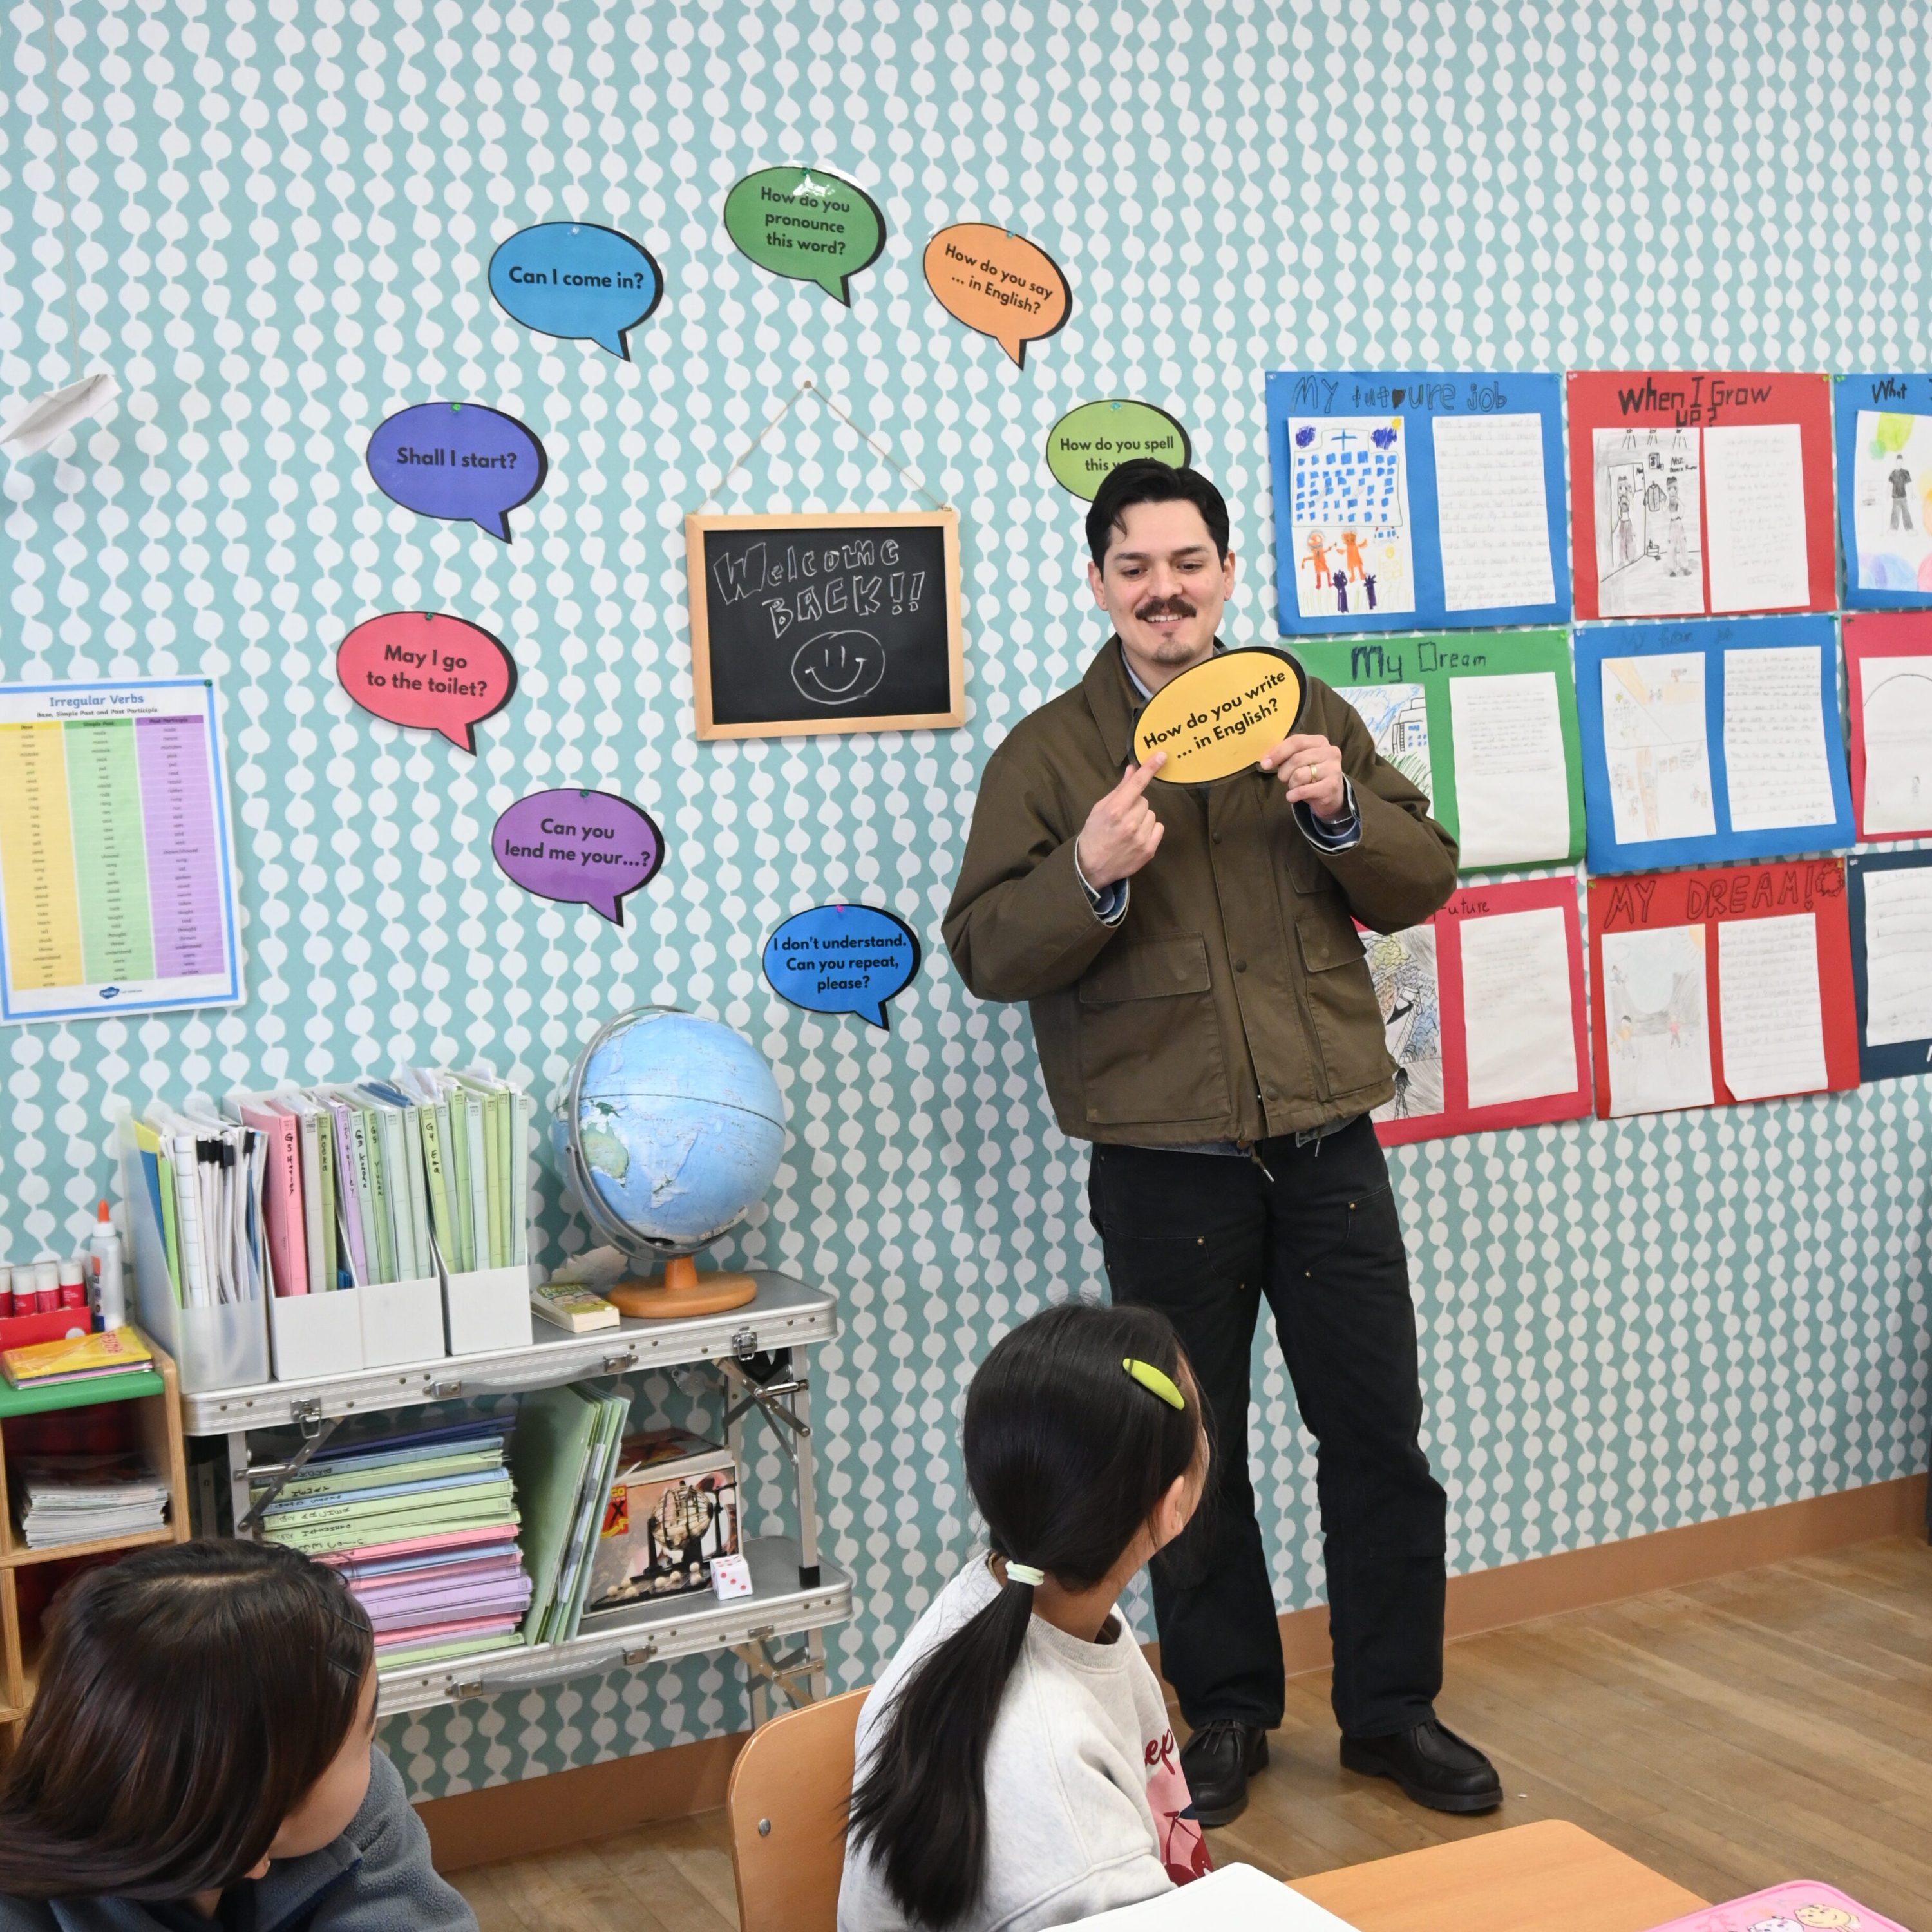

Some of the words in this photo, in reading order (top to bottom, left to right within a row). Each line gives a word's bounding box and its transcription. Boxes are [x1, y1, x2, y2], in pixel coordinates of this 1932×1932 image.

[761, 187, 795, 204] How
[799, 193, 819, 209] do
[822, 200, 850, 214] you
[765, 213, 845, 234] pronounce
[766, 232, 793, 248] this
[797, 240, 846, 256] word?
[509, 267, 547, 285] Can
[553, 269, 558, 285] I
[563, 273, 612, 288] come
[616, 272, 645, 289] in?
[945, 243, 977, 267] How
[980, 258, 998, 276] do
[1000, 268, 1027, 288] you
[1028, 281, 1053, 300] say
[969, 275, 981, 291] in
[984, 281, 1042, 314] English?
[1618, 377, 1685, 415] When
[1690, 376, 1705, 408] I
[1711, 380, 1772, 406] Grow
[1060, 438, 1092, 451] How
[1095, 437, 1112, 450] do
[1115, 441, 1141, 453] you
[1144, 435, 1174, 453] spell
[397, 448, 444, 466] Shall
[451, 449, 456, 467] I
[462, 453, 516, 469] start?
[1085, 458, 1108, 471] this
[713, 539, 900, 605] Welcome
[762, 571, 925, 638] BACK!!
[384, 644, 426, 668] May
[431, 647, 437, 666] I
[442, 655, 468, 672] go
[1351, 644, 1403, 683] My
[366, 671, 386, 687] to
[392, 672, 422, 691] the
[428, 677, 488, 697] toilet?
[50, 694, 106, 709] Irregular
[109, 694, 144, 706] Verbs
[1143, 724, 1182, 749] How
[1187, 713, 1208, 728] do
[1211, 696, 1242, 721] you
[1244, 672, 1285, 699] write
[1193, 736, 1212, 749] in
[1213, 697, 1278, 741] English?
[541, 818, 576, 836] Can
[581, 824, 614, 840] you
[505, 840, 544, 858] lend
[549, 848, 576, 861] me
[581, 850, 651, 867] your...?
[1604, 880, 1657, 929] MY
[1687, 865, 1815, 921] DREAM!
[774, 938, 778, 951] I
[782, 936, 819, 950] don't
[822, 934, 907, 949] understand.
[786, 958, 815, 971] Can
[819, 960, 845, 973] you
[849, 956, 899, 972] repeat,
[817, 976, 870, 994] please?
